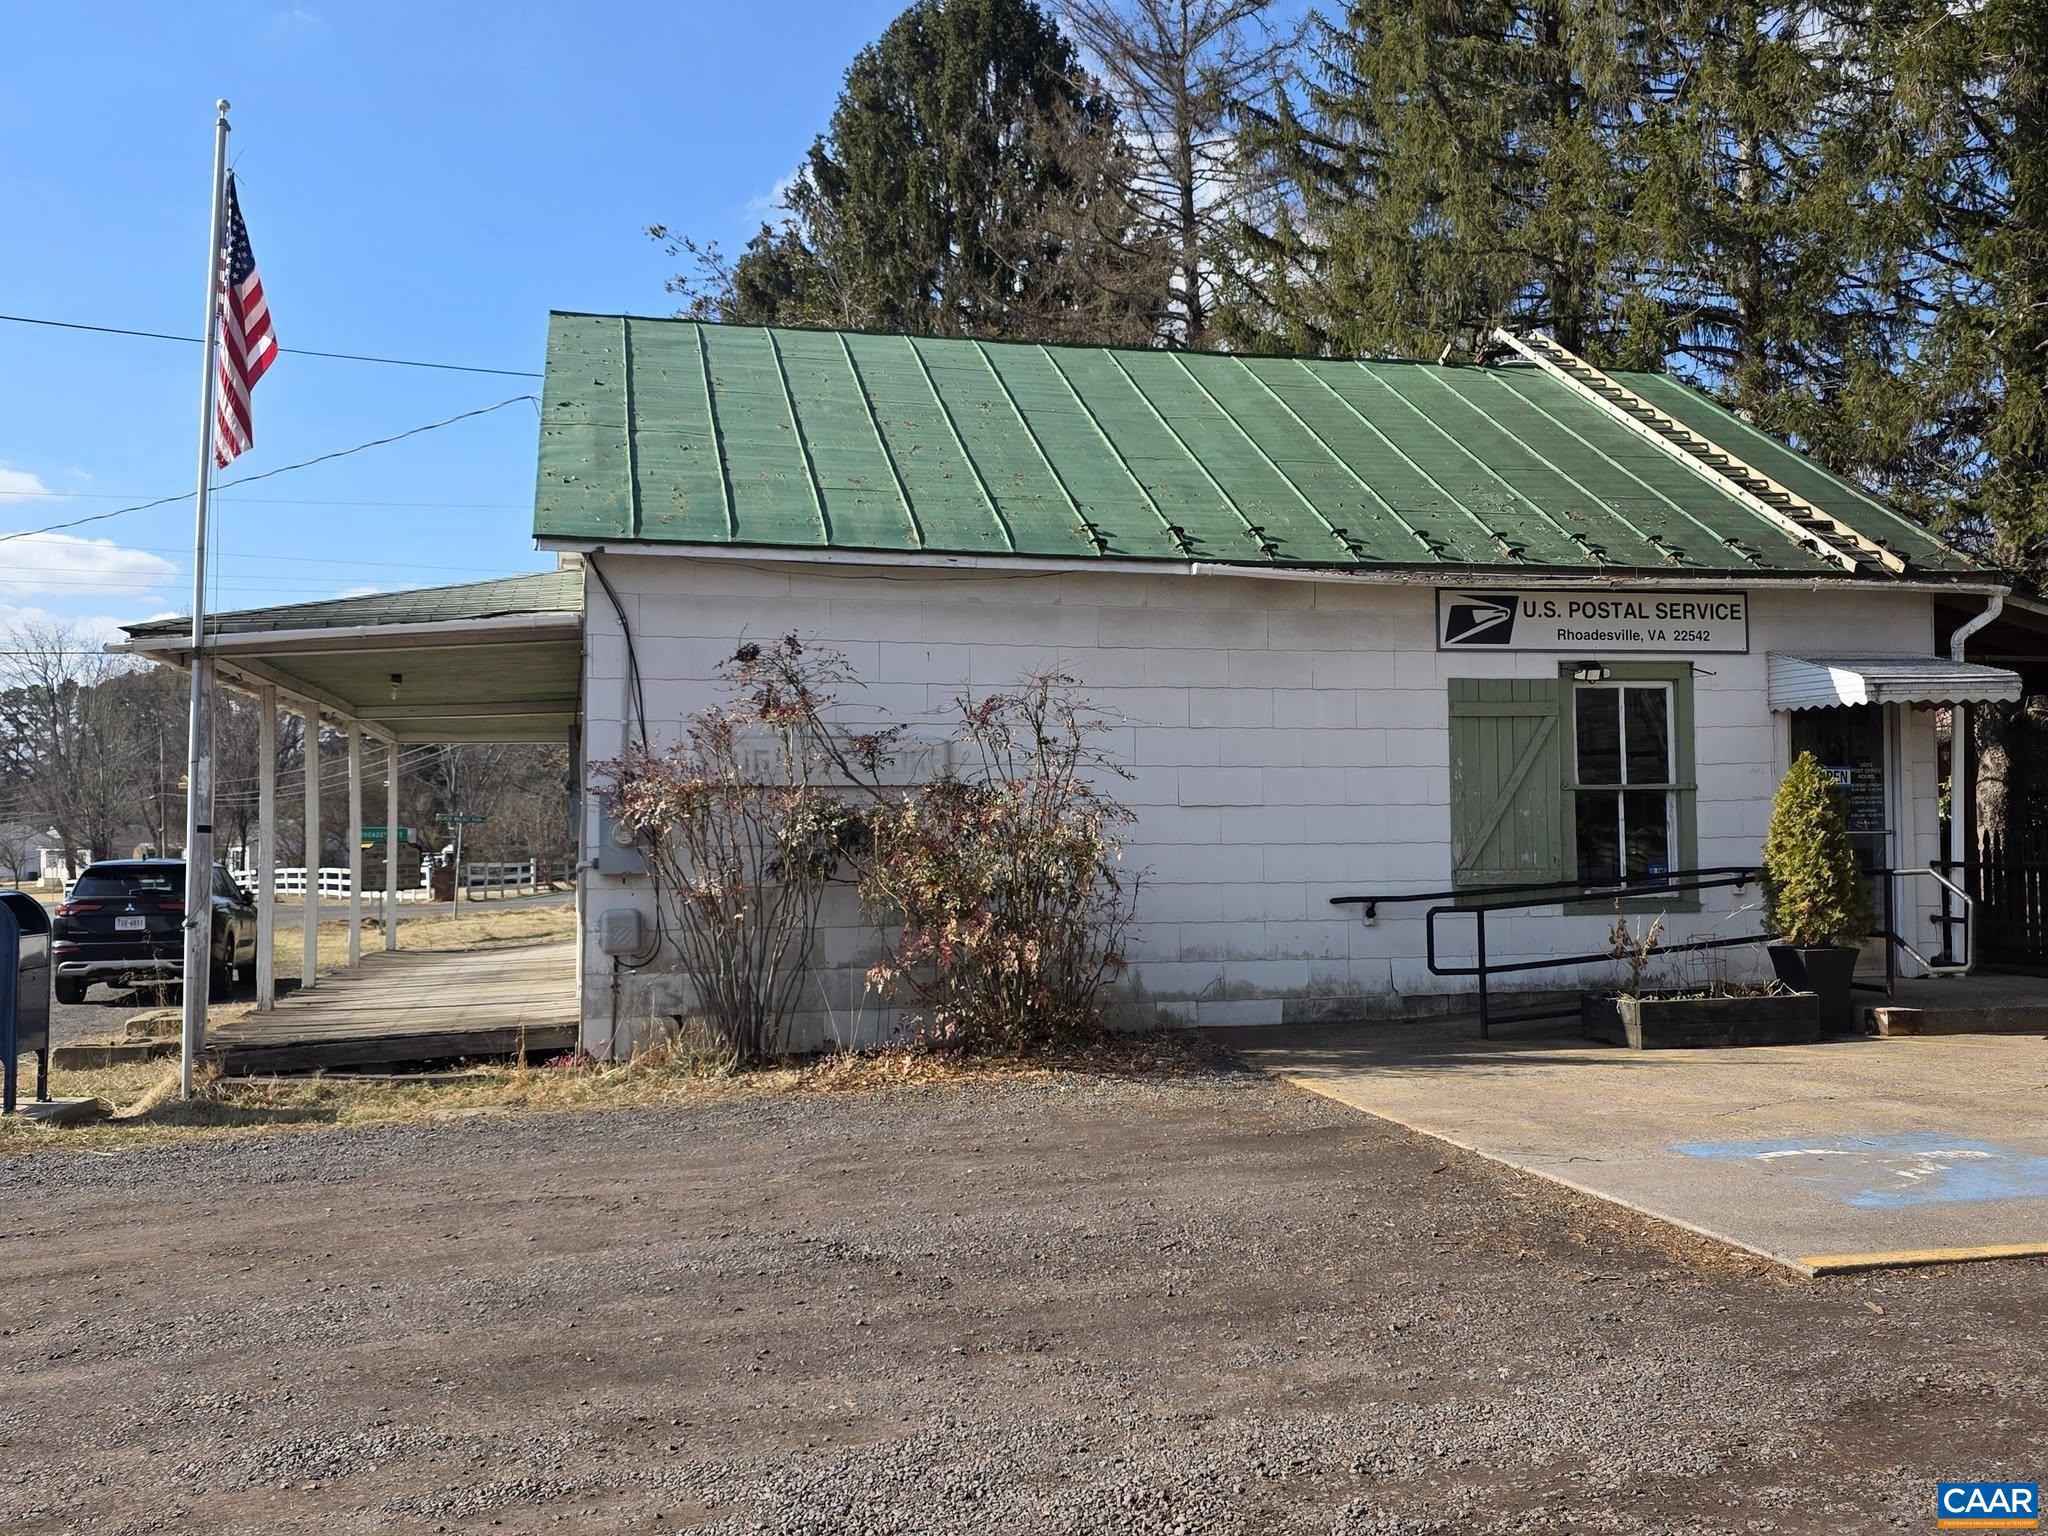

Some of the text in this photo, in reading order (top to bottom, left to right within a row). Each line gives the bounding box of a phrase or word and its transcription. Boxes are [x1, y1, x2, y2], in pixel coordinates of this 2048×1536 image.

[1523, 601, 1742, 620] U.S. POSTAL SERVICE
[1557, 628, 1711, 643] Rhoadesville, VA 22542
[1824, 770, 1848, 784] PEN
